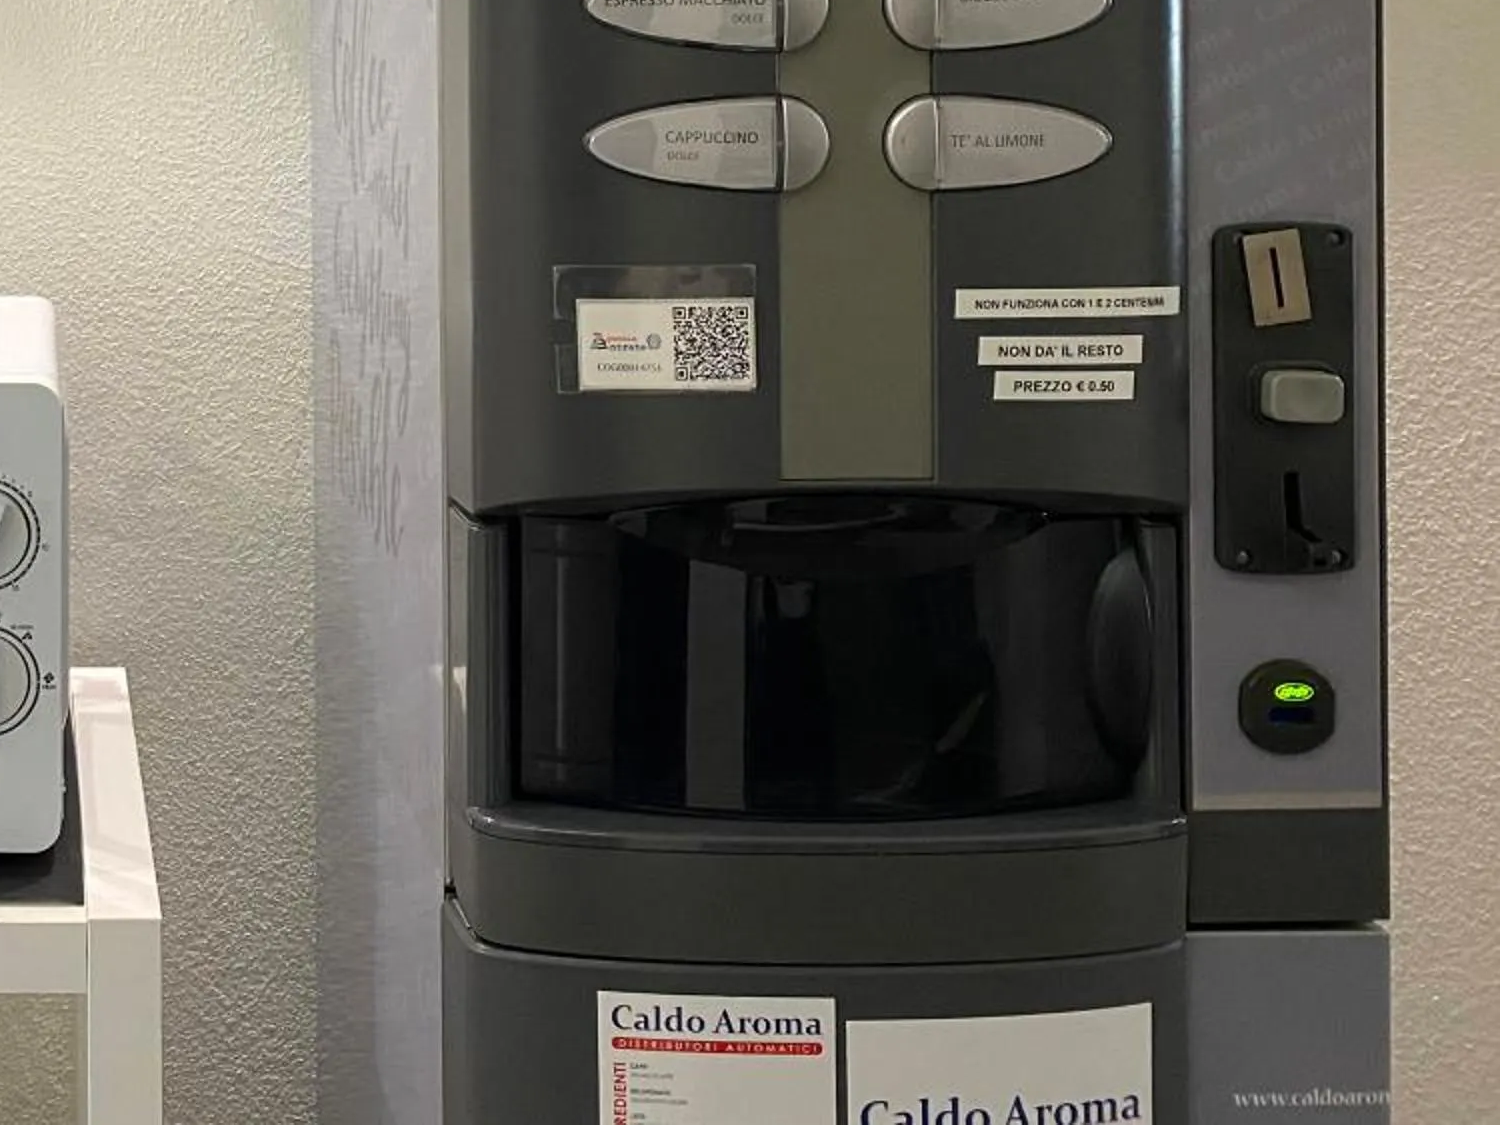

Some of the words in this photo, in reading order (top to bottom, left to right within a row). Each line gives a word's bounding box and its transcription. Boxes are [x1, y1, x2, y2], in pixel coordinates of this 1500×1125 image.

[730, 12, 764, 25] DOLCE
[665, 129, 760, 144] CAPPUCCINO
[975, 134, 994, 148] AL
[995, 133, 1045, 148] LIMONE
[974, 299, 1000, 310] NON
[1002, 298, 1059, 309] FUNZIONA
[1061, 298, 1086, 308] CON
[1105, 298, 1112, 308] 2
[997, 344, 1031, 357] NON
[1035, 345, 1058, 357] DA'
[1061, 344, 1073, 357] IL
[1077, 343, 1124, 357] RESTO
[1013, 379, 1072, 393] PREZZO
[1076, 380, 1085, 392] €
[1087, 379, 1115, 392] 0.50
[611, 1004, 706, 1034] Caldo
[711, 1009, 822, 1036] Aroma
[618, 1037, 718, 1052] DISTRIBUTORI
[725, 1042, 818, 1055] AUTOMATICI
[1005, 1094, 1142, 1125] Aroma
